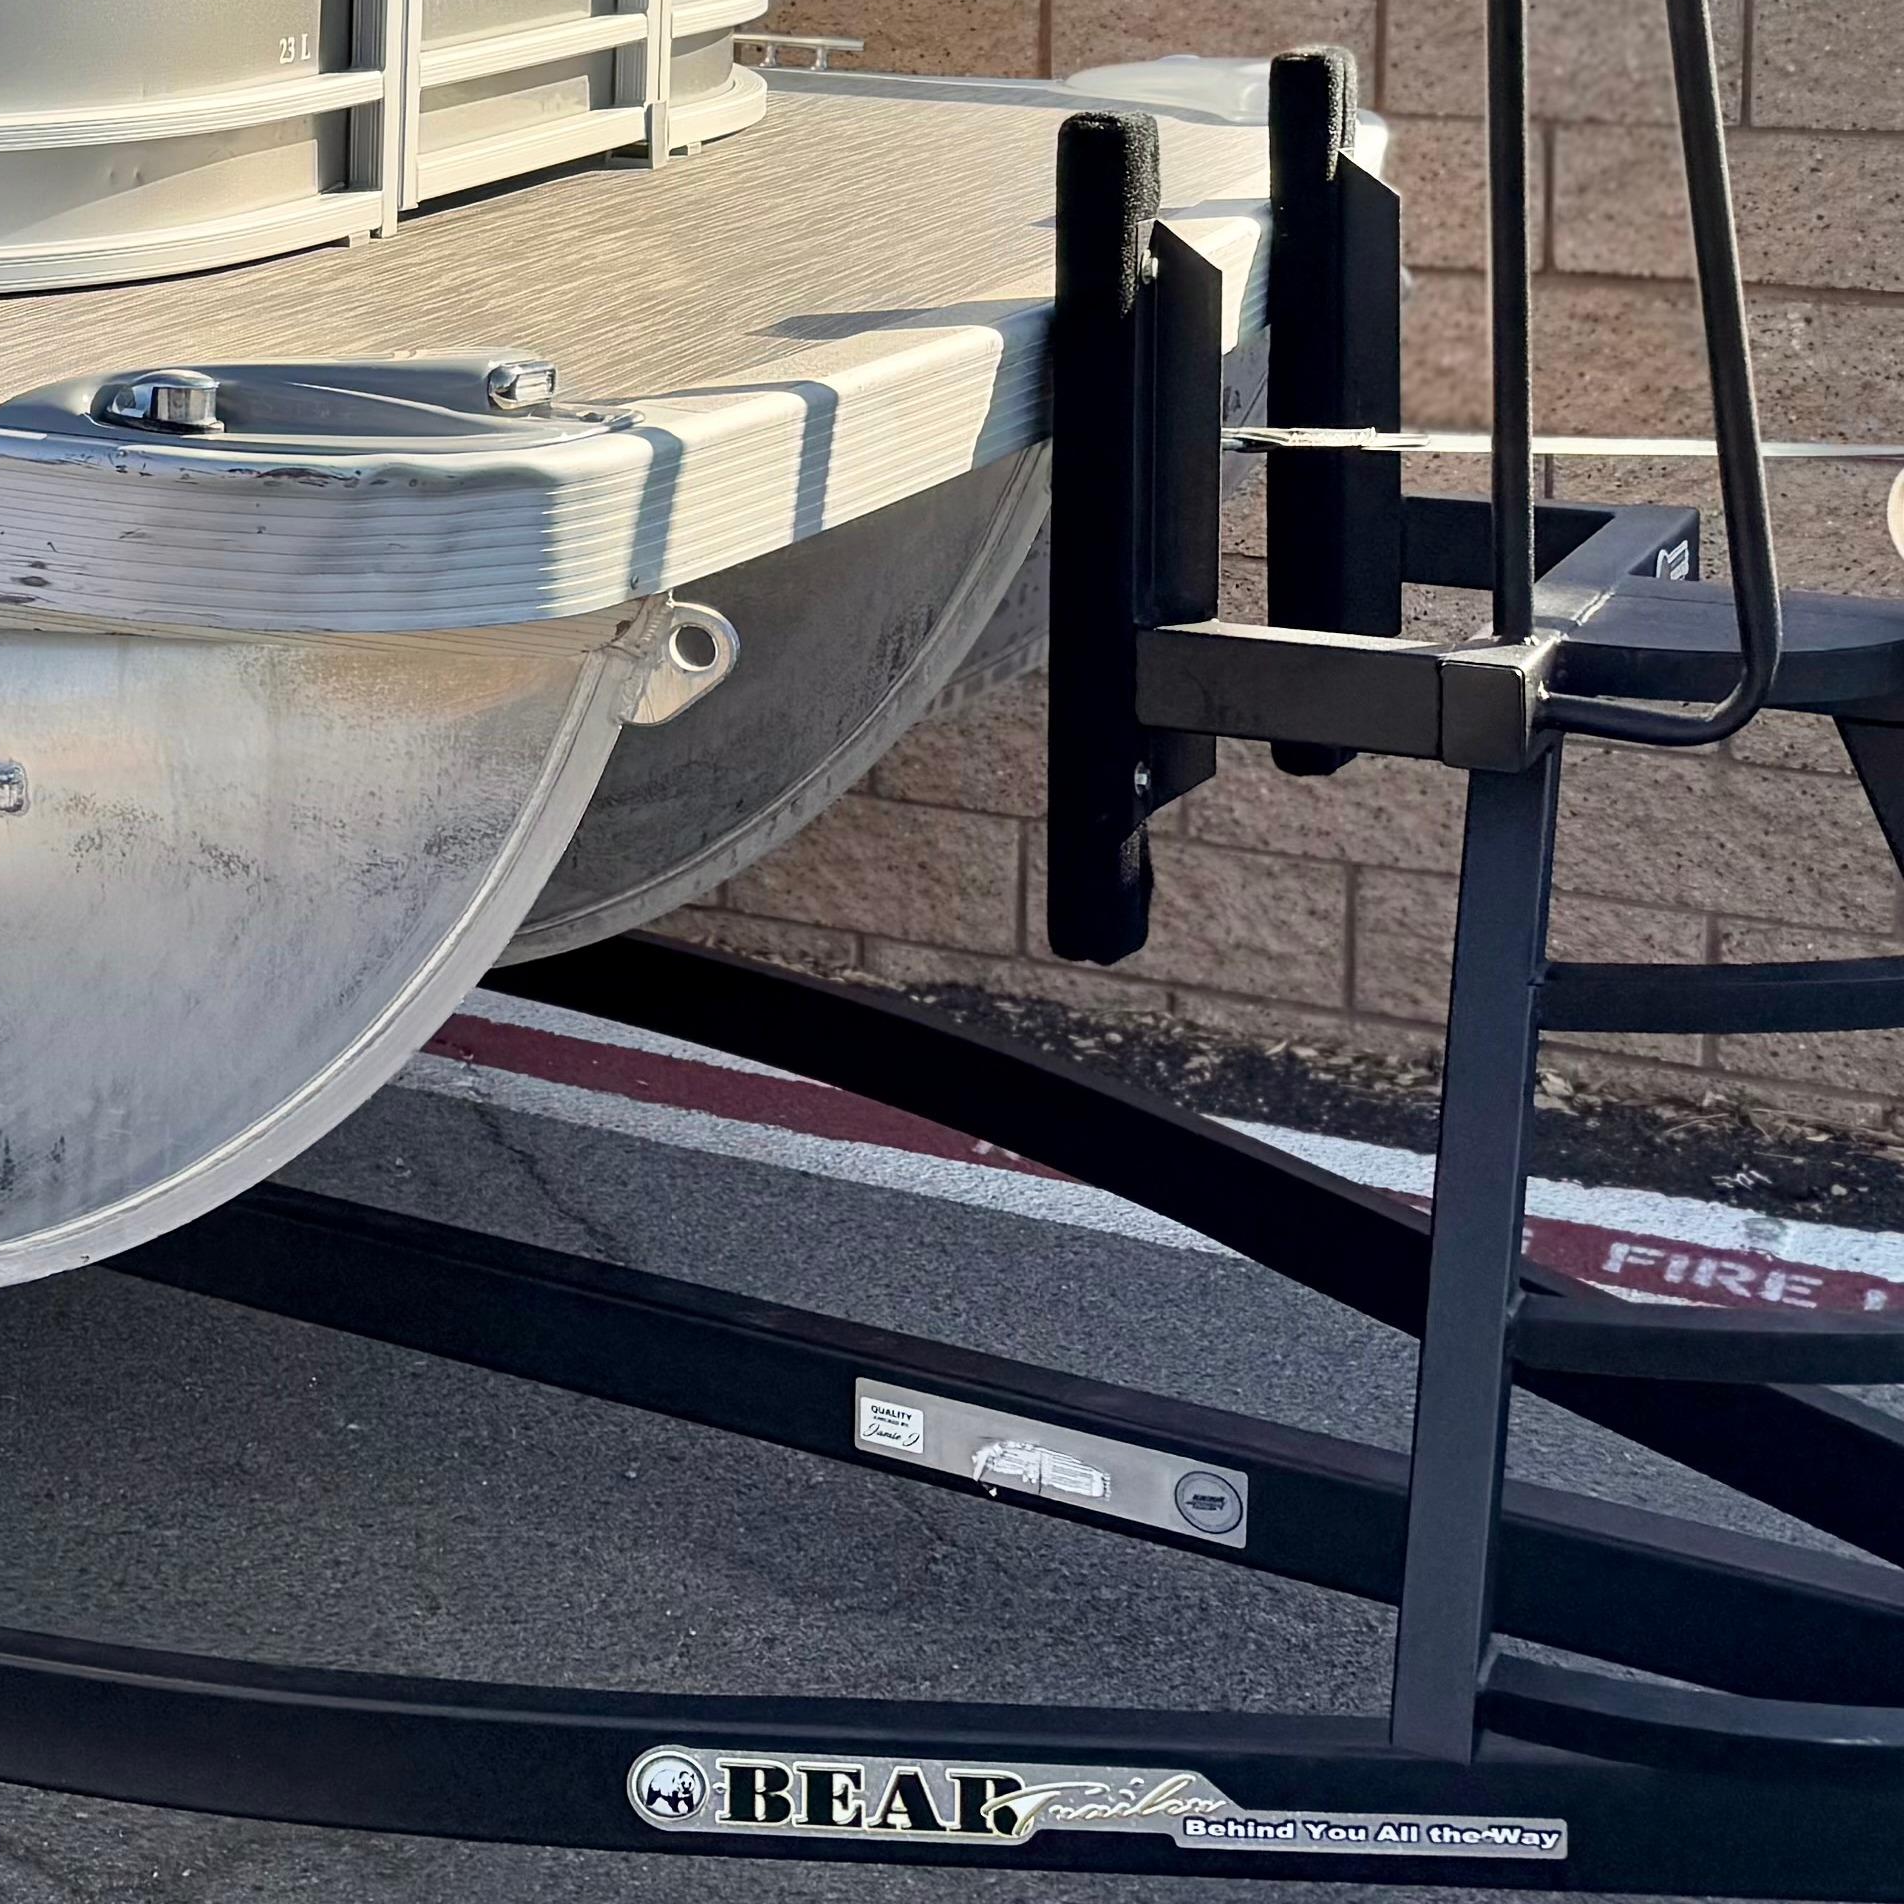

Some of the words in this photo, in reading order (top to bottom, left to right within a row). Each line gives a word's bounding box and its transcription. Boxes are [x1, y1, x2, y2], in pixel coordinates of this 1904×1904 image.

[1601, 1241, 1824, 1309] FIRE
[871, 1405, 912, 1421] QUALITY
[715, 1756, 1034, 1838] BEAR
[1184, 1817, 1295, 1840] Behind
[1303, 1821, 1368, 1842] You
[1375, 1823, 1420, 1844] All
